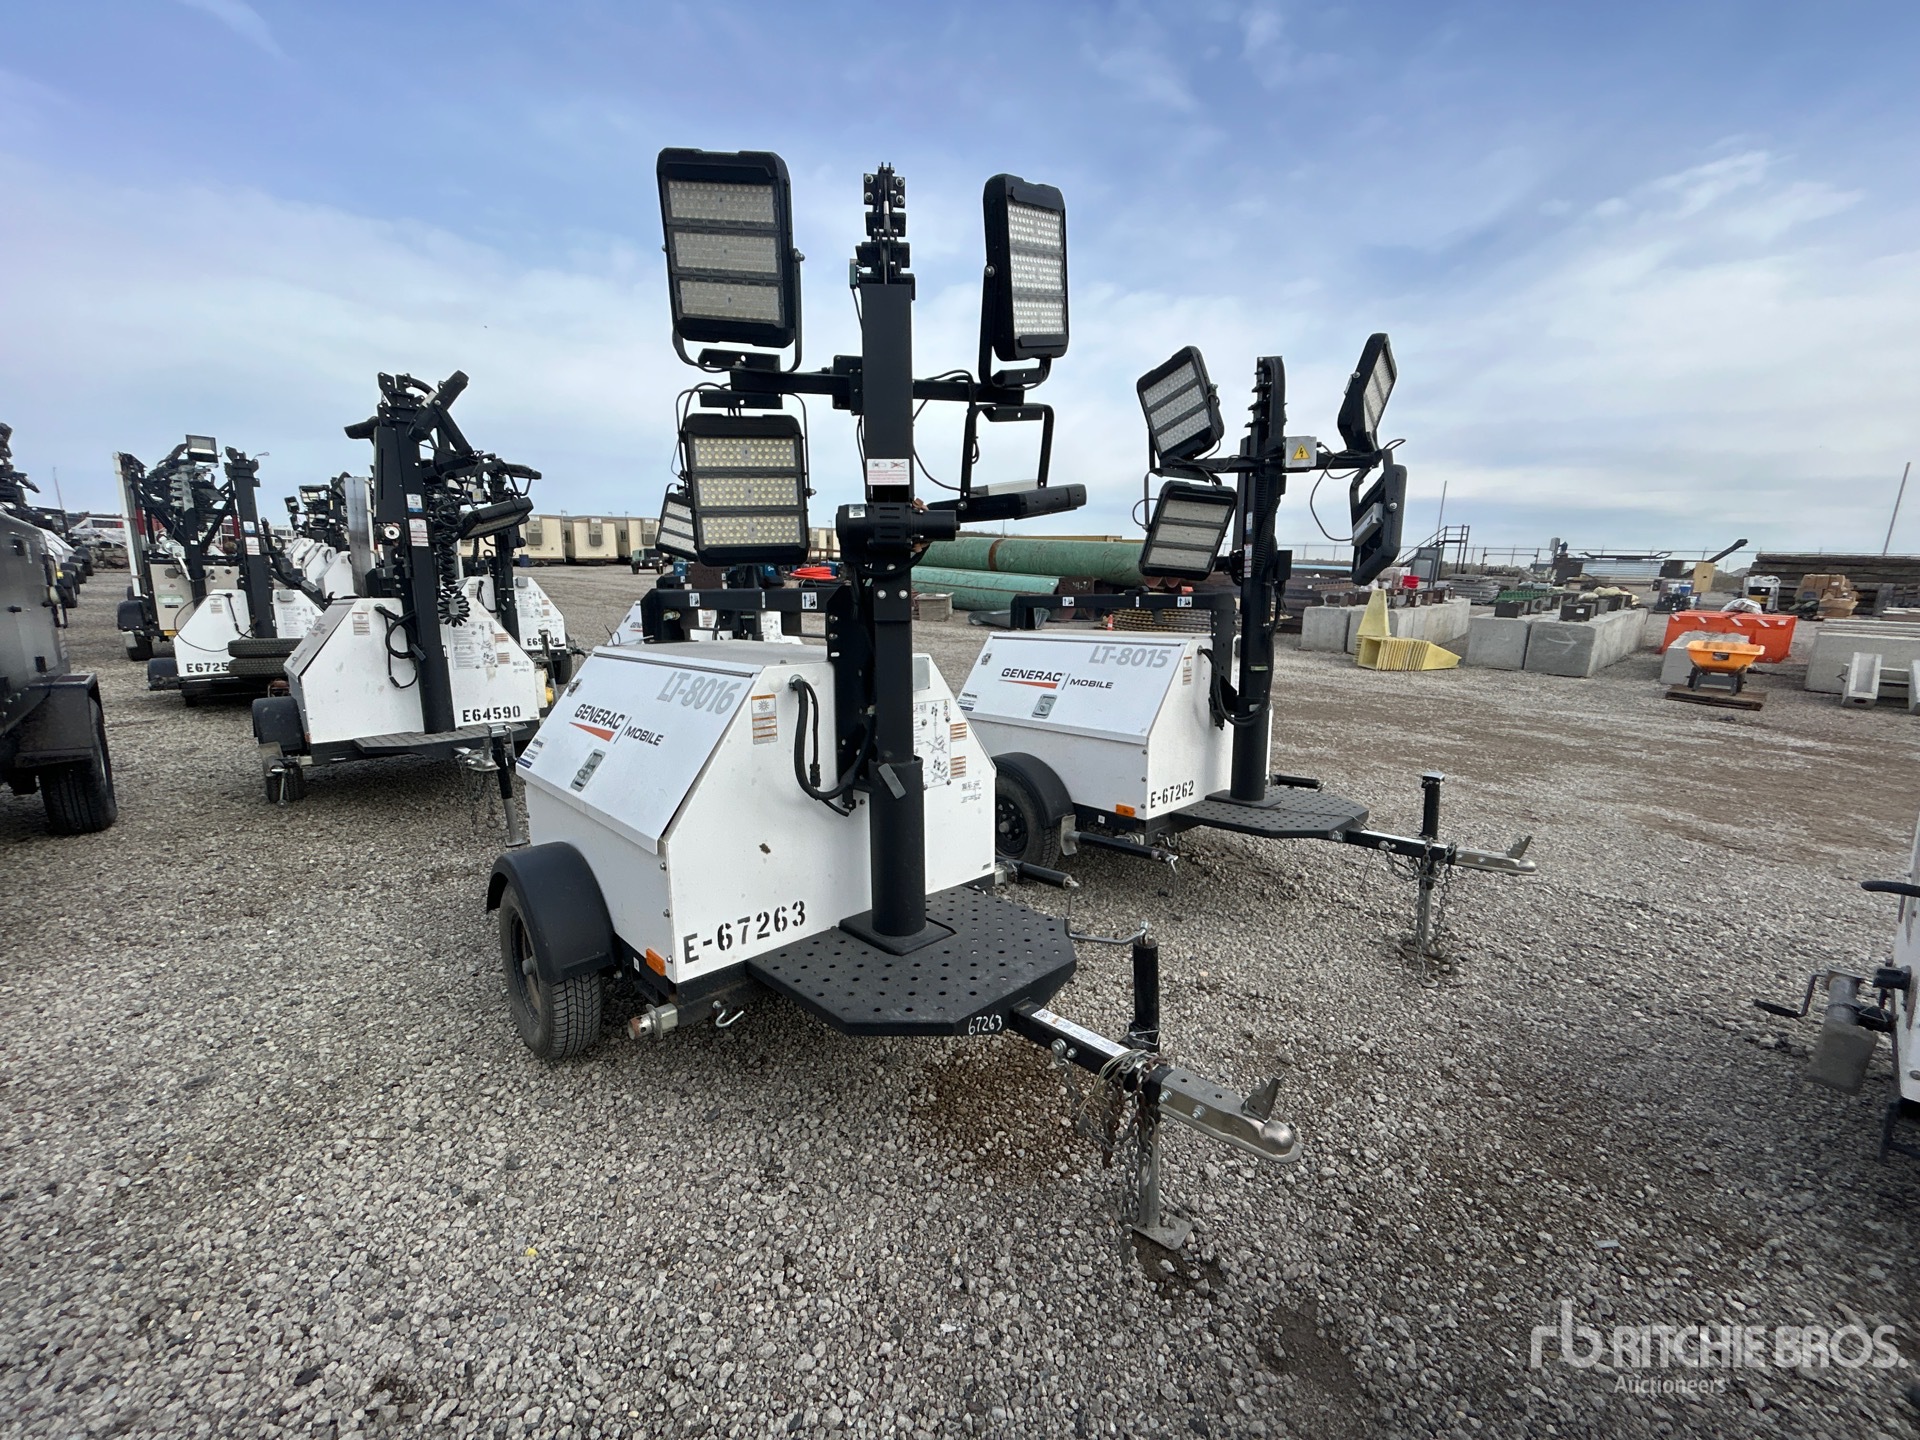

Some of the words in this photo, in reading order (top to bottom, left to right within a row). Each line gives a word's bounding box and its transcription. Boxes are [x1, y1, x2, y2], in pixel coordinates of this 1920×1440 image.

[186, 662, 229, 673] E6725
[1088, 645, 1172, 669] LT-8015
[1001, 668, 1063, 682] GENERAC
[1069, 678, 1114, 689] MOBILE
[656, 671, 742, 715] LT-8016
[462, 705, 521, 722] E64590
[574, 703, 626, 730] GENERAC
[623, 725, 664, 747] MOBILE
[1150, 779, 1194, 809] E-67262
[683, 900, 806, 965] E-67263
